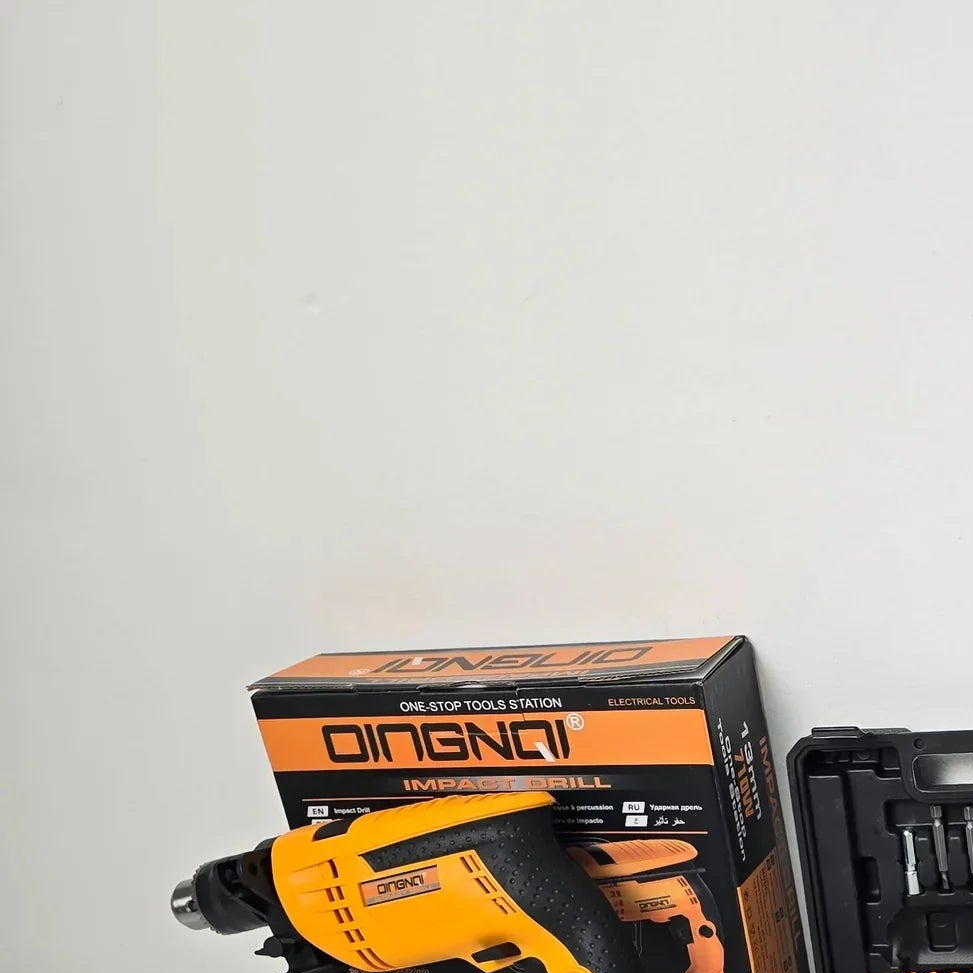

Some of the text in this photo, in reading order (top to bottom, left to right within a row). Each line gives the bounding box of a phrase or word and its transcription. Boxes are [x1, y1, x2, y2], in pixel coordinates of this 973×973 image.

[400, 698, 563, 713] ONE-STOP TOOLS STATION
[608, 696, 696, 707] ELECTRICAL TOOLS
[741, 721, 763, 820] 13mm
[403, 776, 612, 791] IMPACT DRILL
[724, 735, 747, 839] One-Stop
[734, 748, 755, 818] 710W
[716, 717, 747, 862] Tools Station
[312, 807, 324, 815] EN
[333, 806, 371, 815] Impact Drill
[576, 803, 614, 813] percussion
[628, 803, 640, 811] RU
[649, 803, 703, 812] Ударная дрель
[577, 817, 604, 825] impacto
[671, 817, 686, 827] حفر
